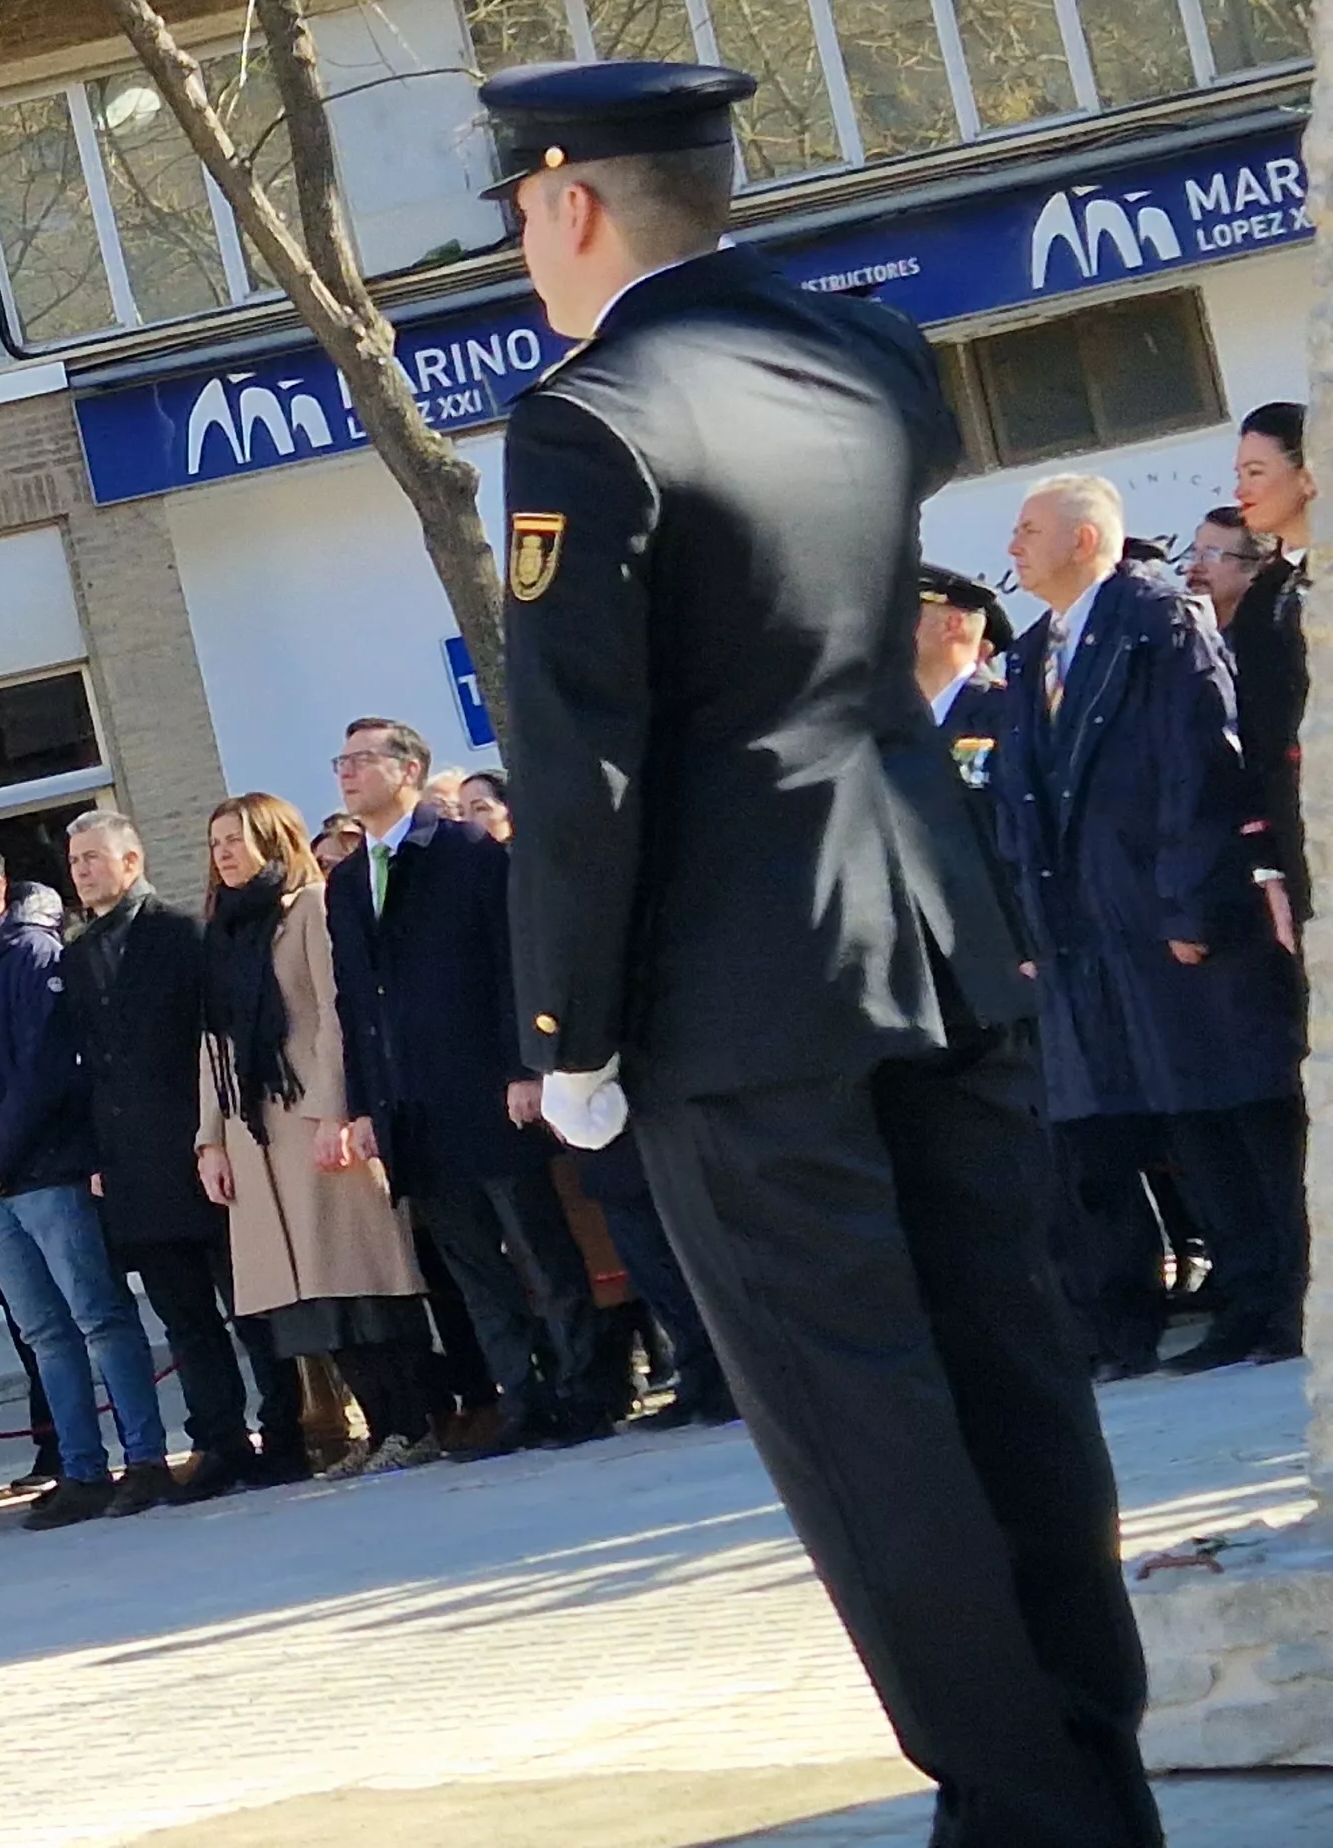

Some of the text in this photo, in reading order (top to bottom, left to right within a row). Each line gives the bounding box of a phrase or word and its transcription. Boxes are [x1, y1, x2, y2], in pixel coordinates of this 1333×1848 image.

[1196, 210, 1288, 251] LOPEZ
[801, 256, 922, 293] STRUCTORES
[438, 388, 483, 420] XXI
